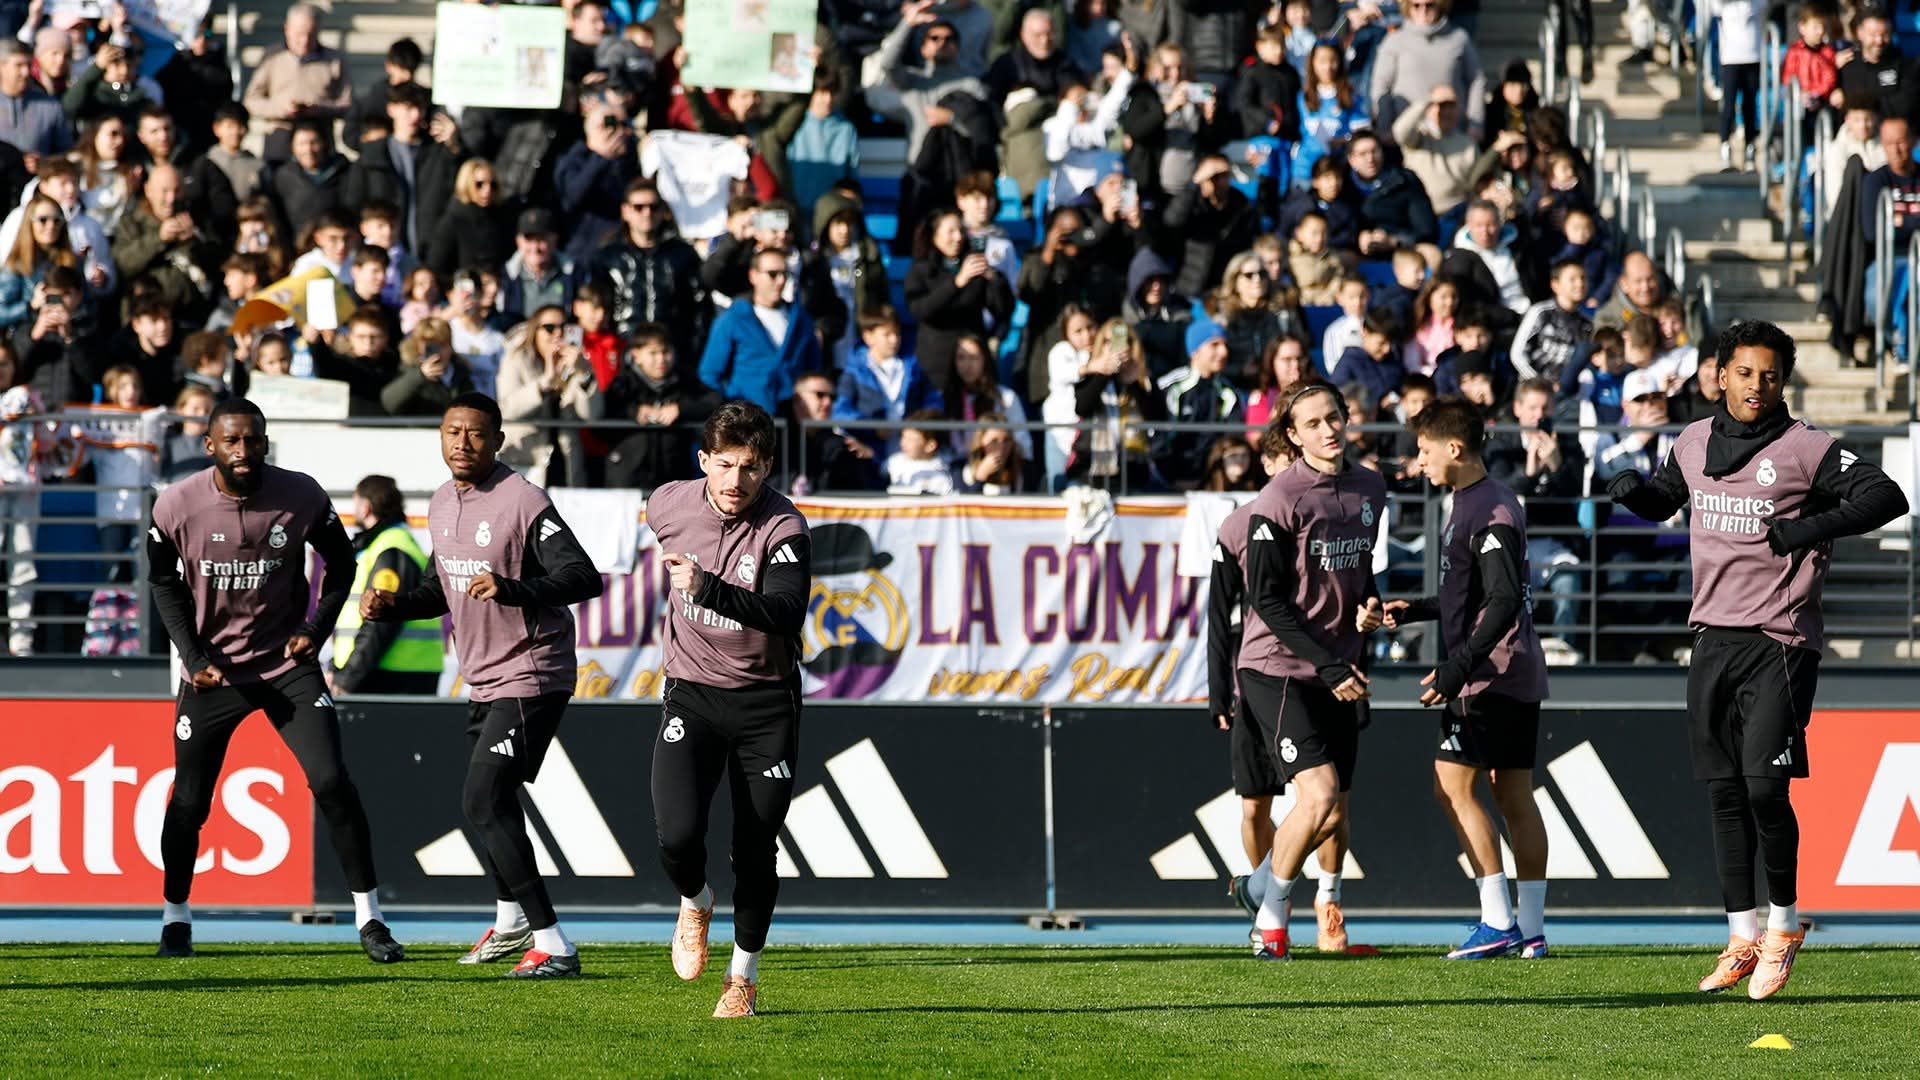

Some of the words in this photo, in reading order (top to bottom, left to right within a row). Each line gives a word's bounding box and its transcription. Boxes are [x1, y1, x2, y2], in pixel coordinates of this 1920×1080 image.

[1693, 489, 1776, 515] Emirates
[1702, 512, 1719, 530] FLY
[1720, 515, 1761, 534] BETTER
[211, 533, 226, 542] 22
[917, 544, 1000, 646] LA
[683, 603, 701, 623] FLY
